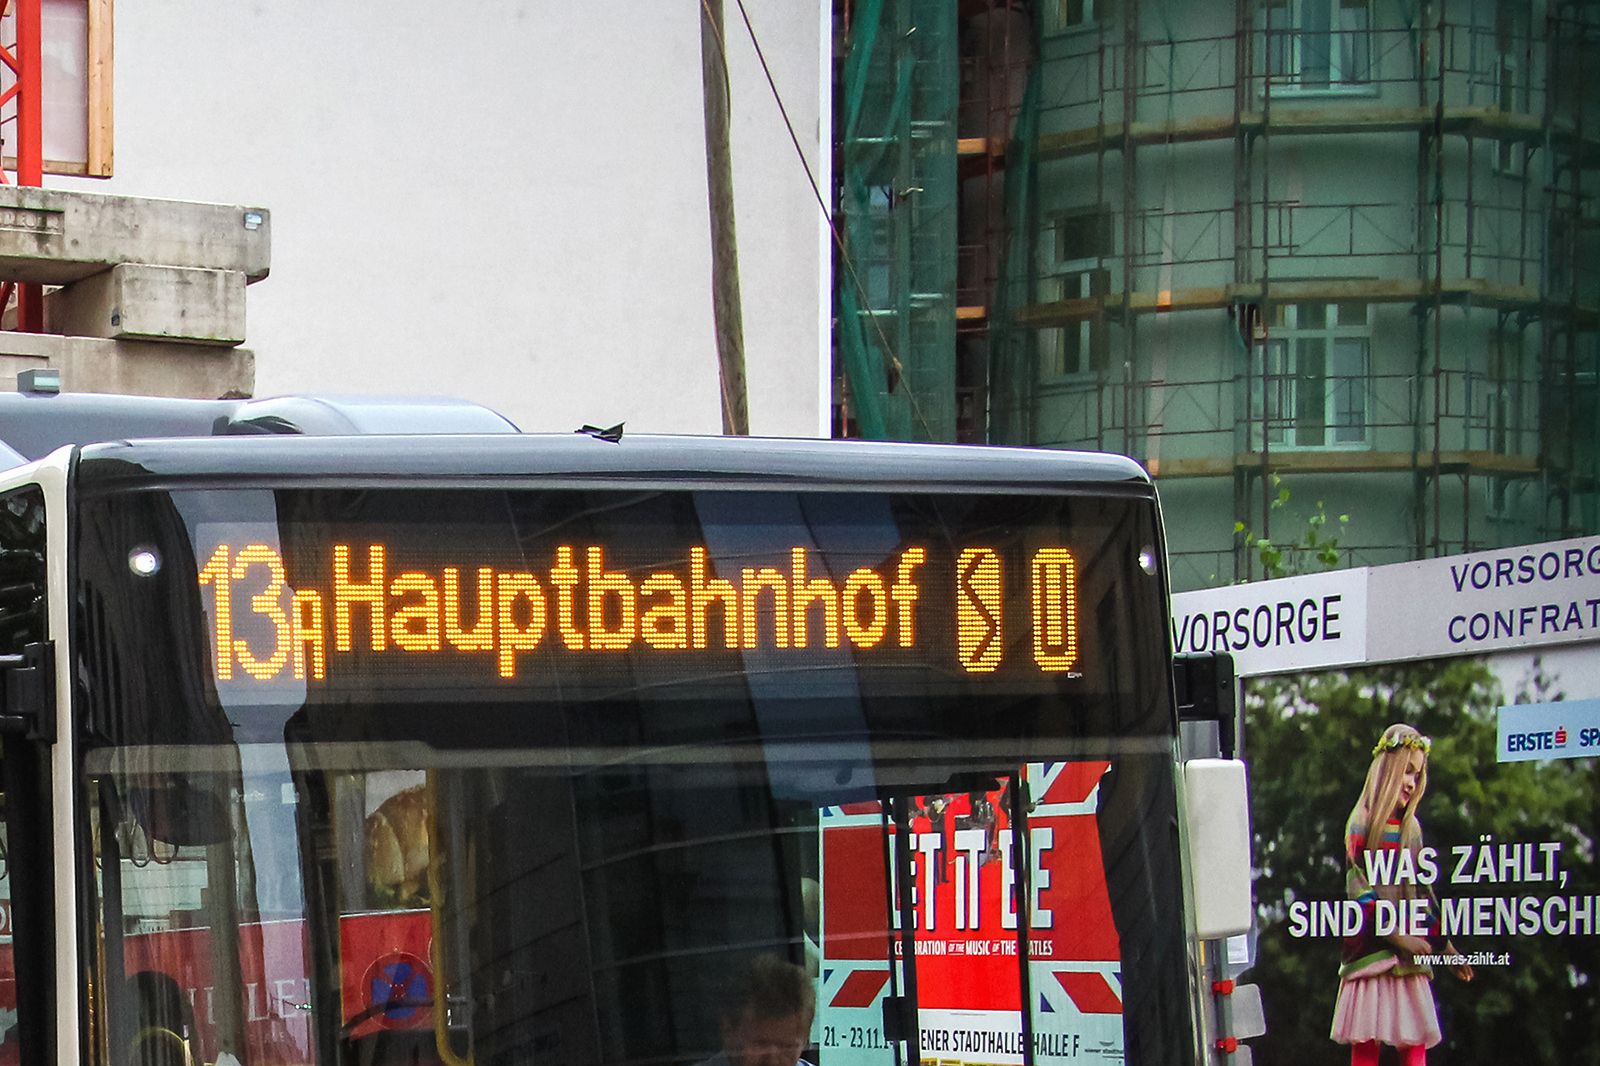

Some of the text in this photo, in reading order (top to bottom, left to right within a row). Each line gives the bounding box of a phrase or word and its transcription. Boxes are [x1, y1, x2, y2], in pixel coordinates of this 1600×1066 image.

[334, 544, 925, 678] Hauptbahnhof
[1172, 595, 1341, 652] VORSORGE
[1507, 731, 1553, 752] ERSTE
[1363, 834, 1568, 889] WAS ZÄHLT,
[1288, 901, 1364, 937] SIND
[1375, 899, 1429, 936] DIE
[965, 940, 990, 955] MUSIC
[1000, 939, 1016, 955] THE
[1413, 952, 1510, 966] www.was-zählt.at
[824, 1026, 839, 1047] 21.
[850, 1027, 894, 1049] 23.11.
[1073, 1035, 1080, 1058] F
